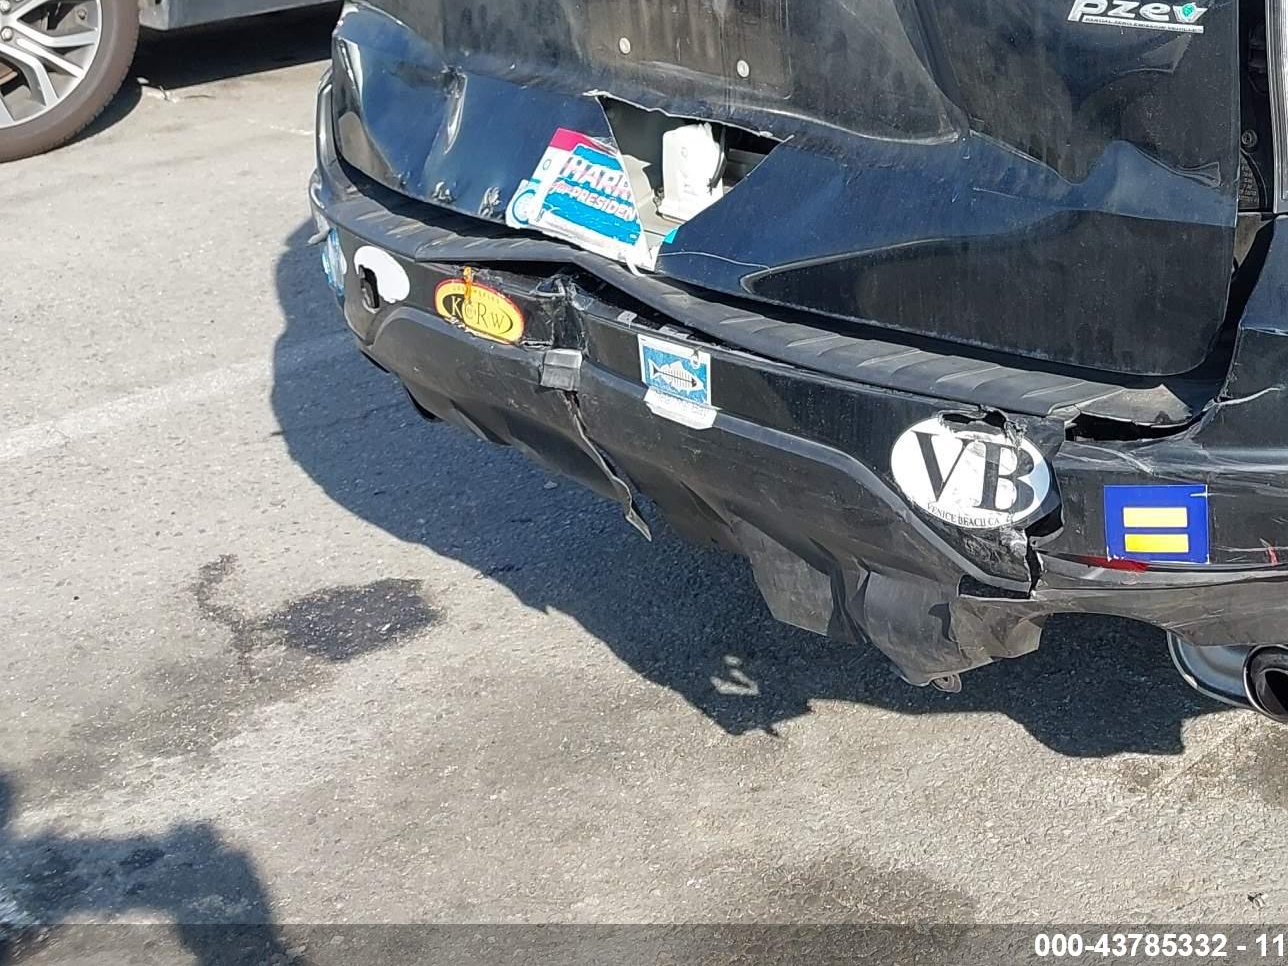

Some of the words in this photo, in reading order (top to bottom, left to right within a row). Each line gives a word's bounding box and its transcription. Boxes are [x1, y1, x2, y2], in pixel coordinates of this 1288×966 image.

[572, 186, 639, 224] PRESIDEN
[911, 429, 1036, 514] VB
[927, 502, 957, 523] VENICE
